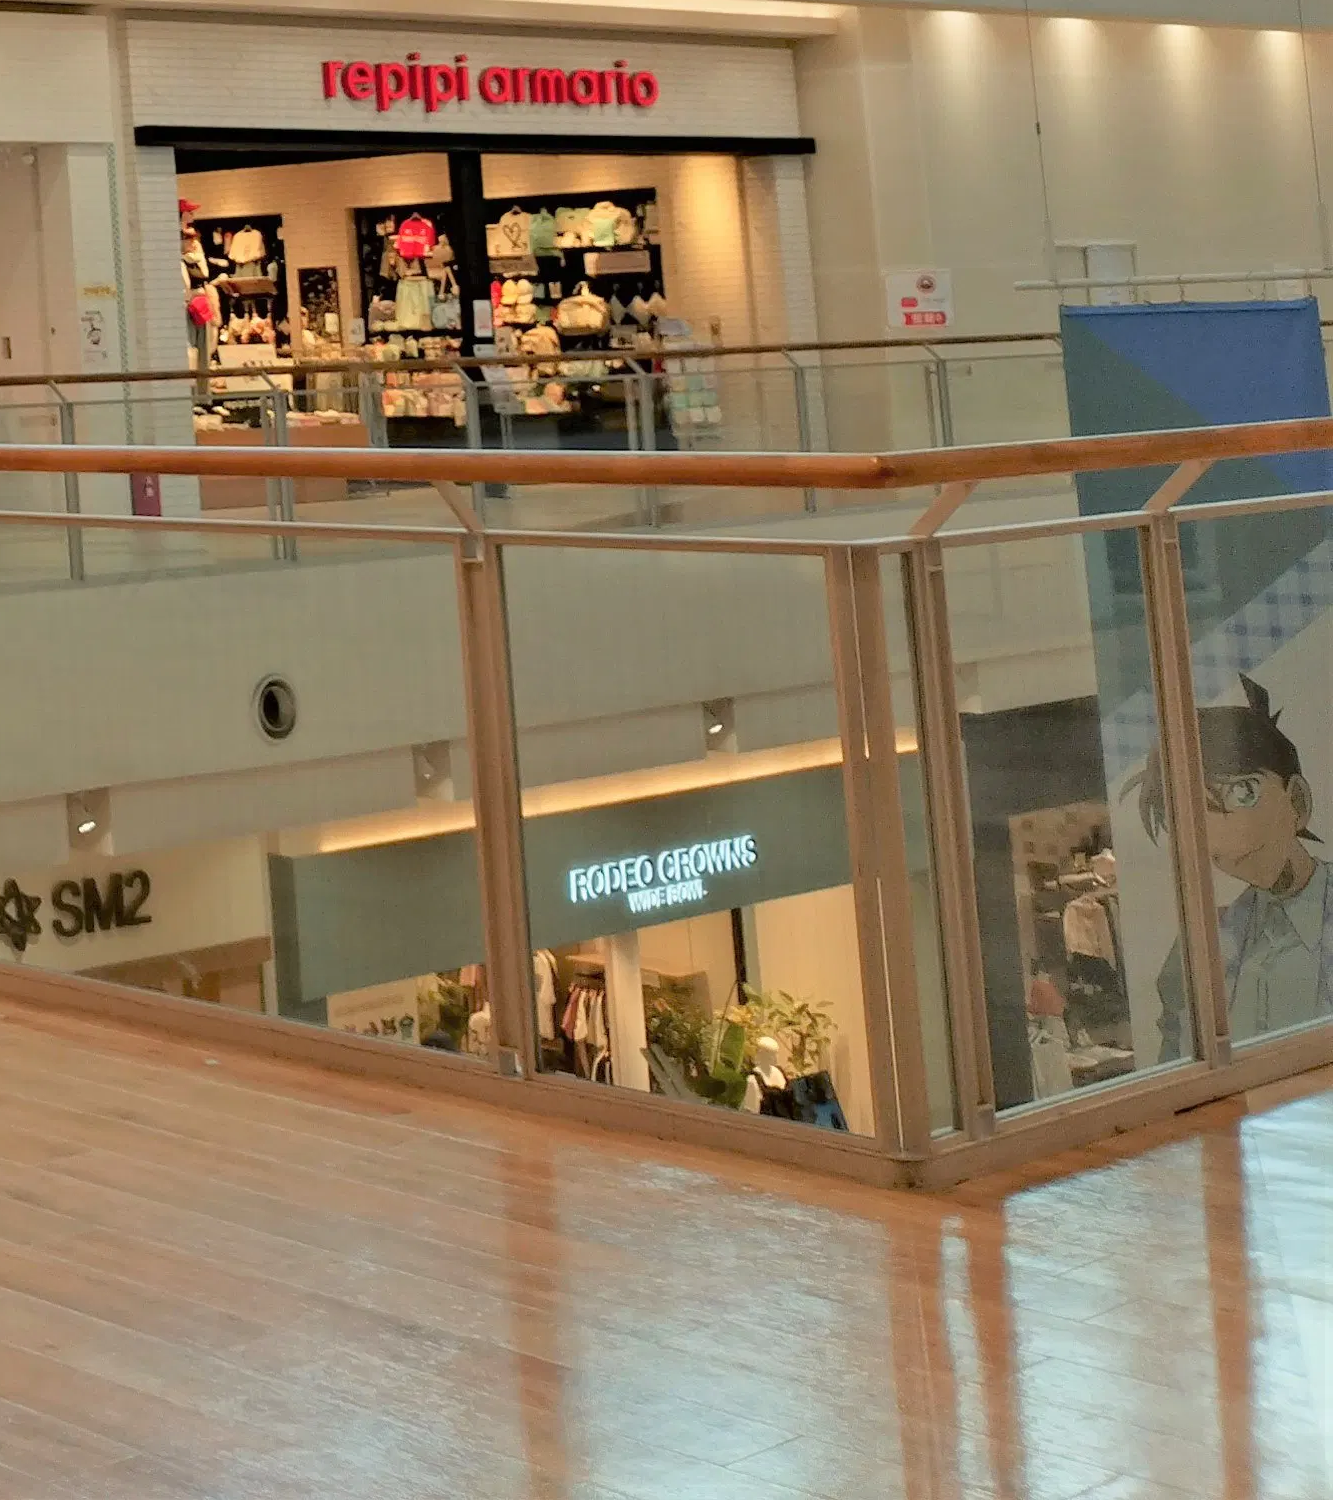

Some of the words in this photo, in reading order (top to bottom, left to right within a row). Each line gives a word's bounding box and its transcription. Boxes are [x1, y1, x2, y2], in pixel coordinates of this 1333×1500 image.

[321, 51, 470, 112] repipi
[478, 59, 660, 107] armario
[51, 869, 153, 938] SM2
